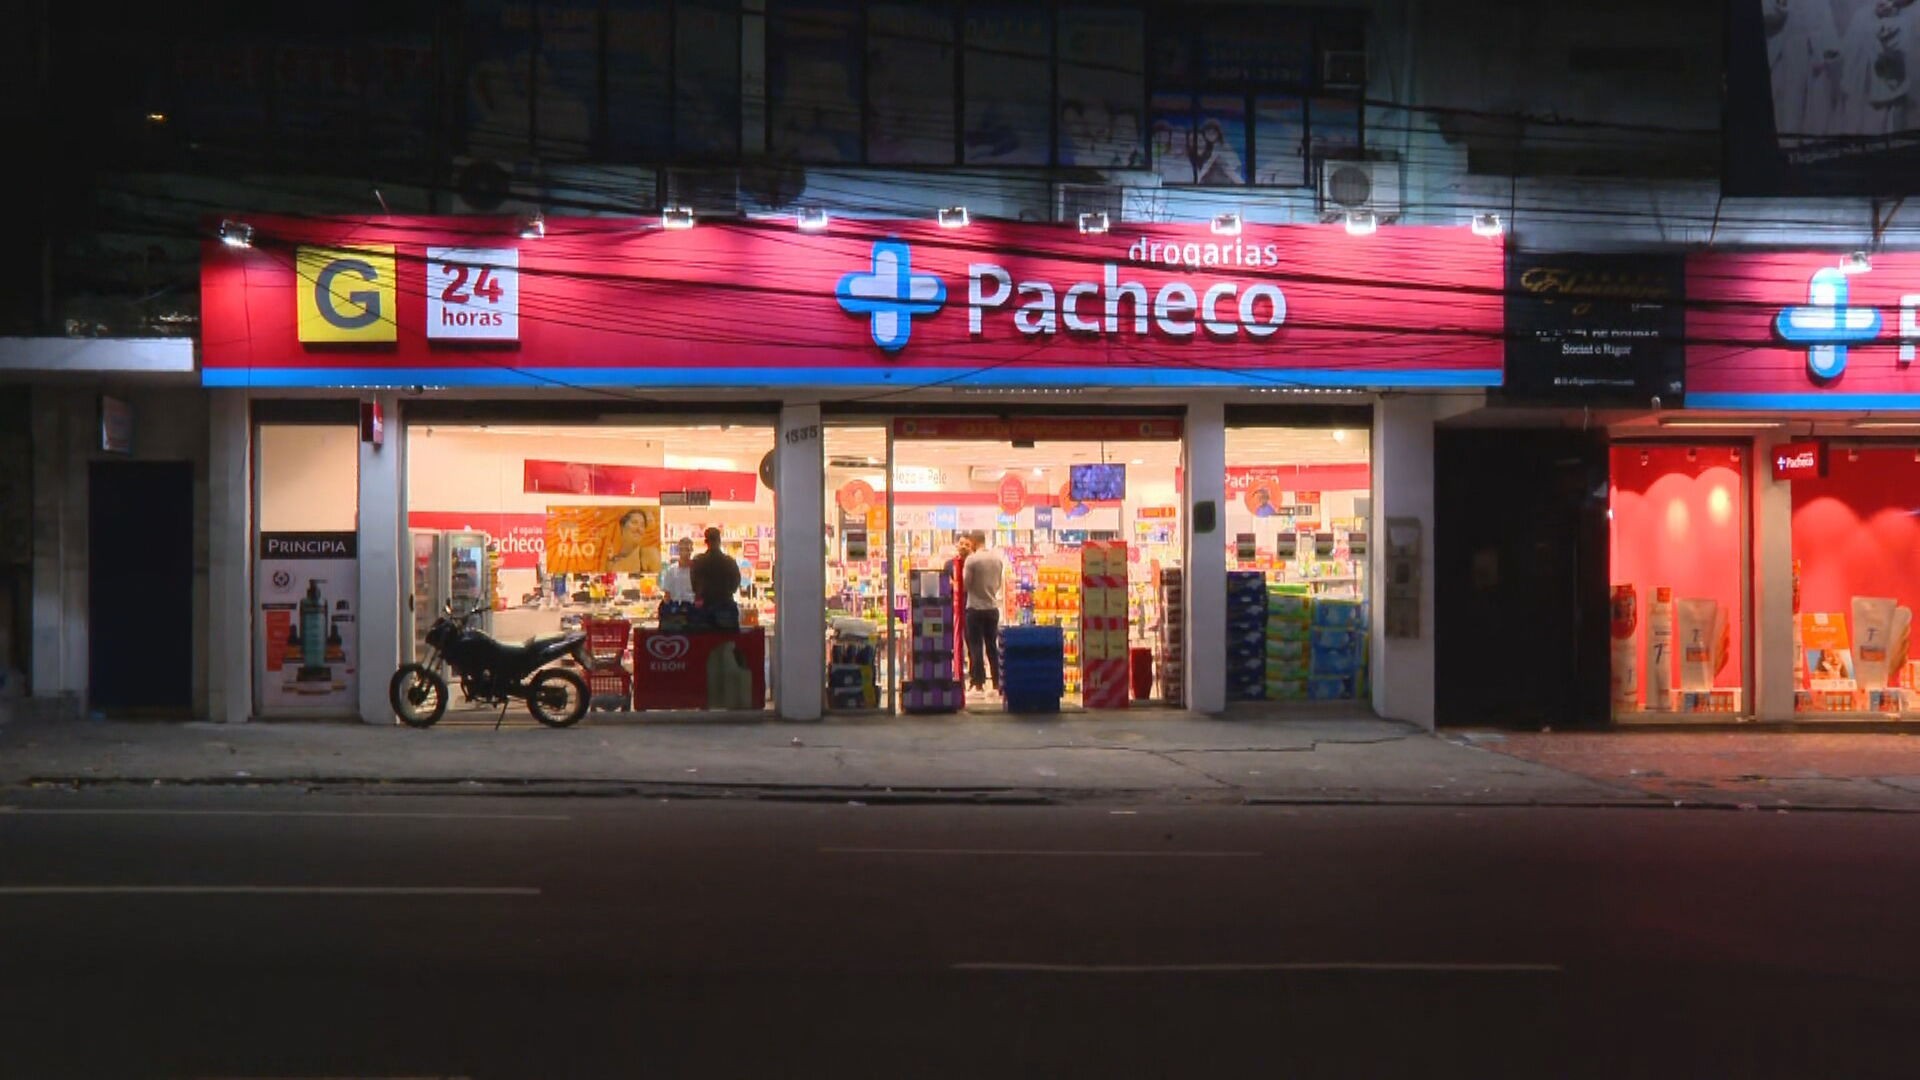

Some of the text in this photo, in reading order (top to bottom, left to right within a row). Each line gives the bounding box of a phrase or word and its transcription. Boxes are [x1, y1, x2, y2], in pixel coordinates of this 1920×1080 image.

[1129, 236, 1278, 271] drogarias
[314, 259, 381, 329] G
[440, 264, 504, 304] 24
[967, 263, 1288, 338] Pacheco
[441, 306, 503, 327] horas
[268, 538, 347, 554] PRINCIPIA
[484, 532, 545, 554] Pacheco
